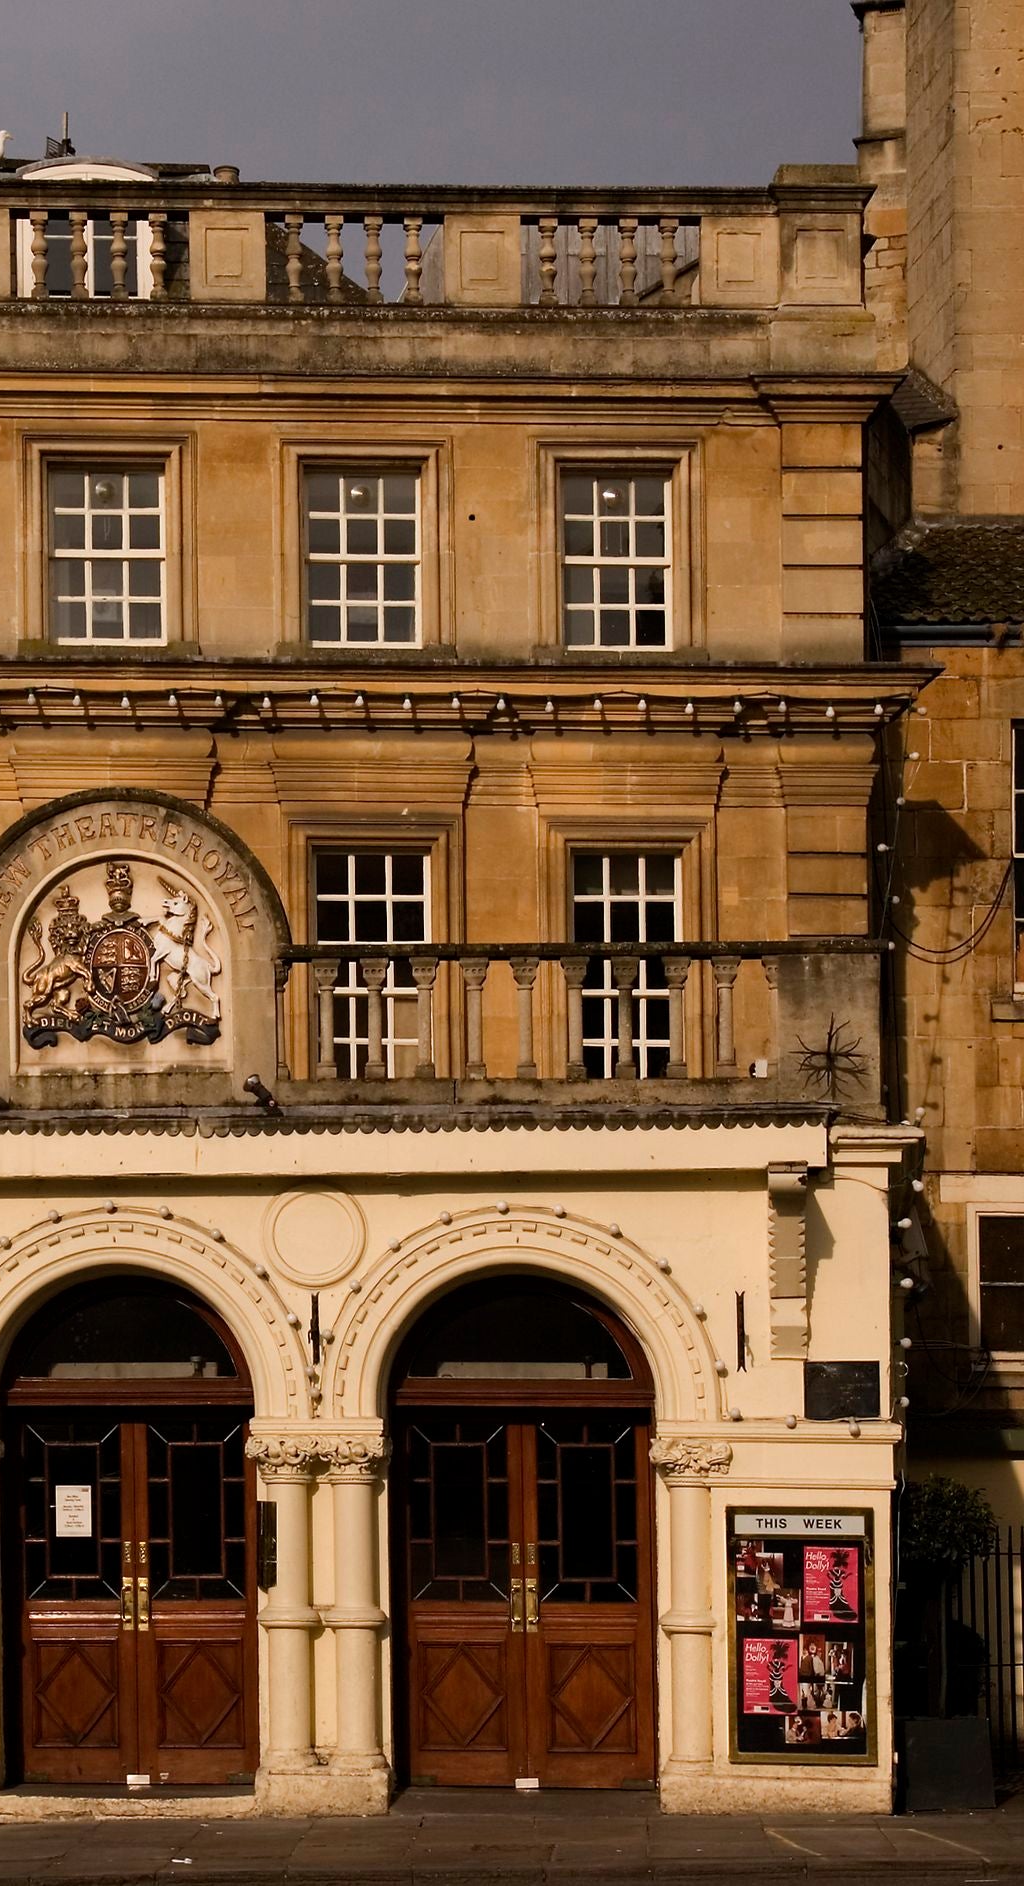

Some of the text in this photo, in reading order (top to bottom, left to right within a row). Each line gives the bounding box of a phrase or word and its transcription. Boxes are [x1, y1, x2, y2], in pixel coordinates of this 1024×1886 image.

[27, 812, 183, 861] THEATRE
[181, 833, 259, 933] ROYAL
[92, 1020, 111, 1032] ET
[115, 1023, 145, 1038] MON
[756, 1518, 843, 1529] THIS WEEK
[806, 1551, 828, 1562] Hello,
[806, 1560, 830, 1573] Dolly!
[746, 1642, 768, 1654] Hello,
[746, 1652, 770, 1665] Dolly!
